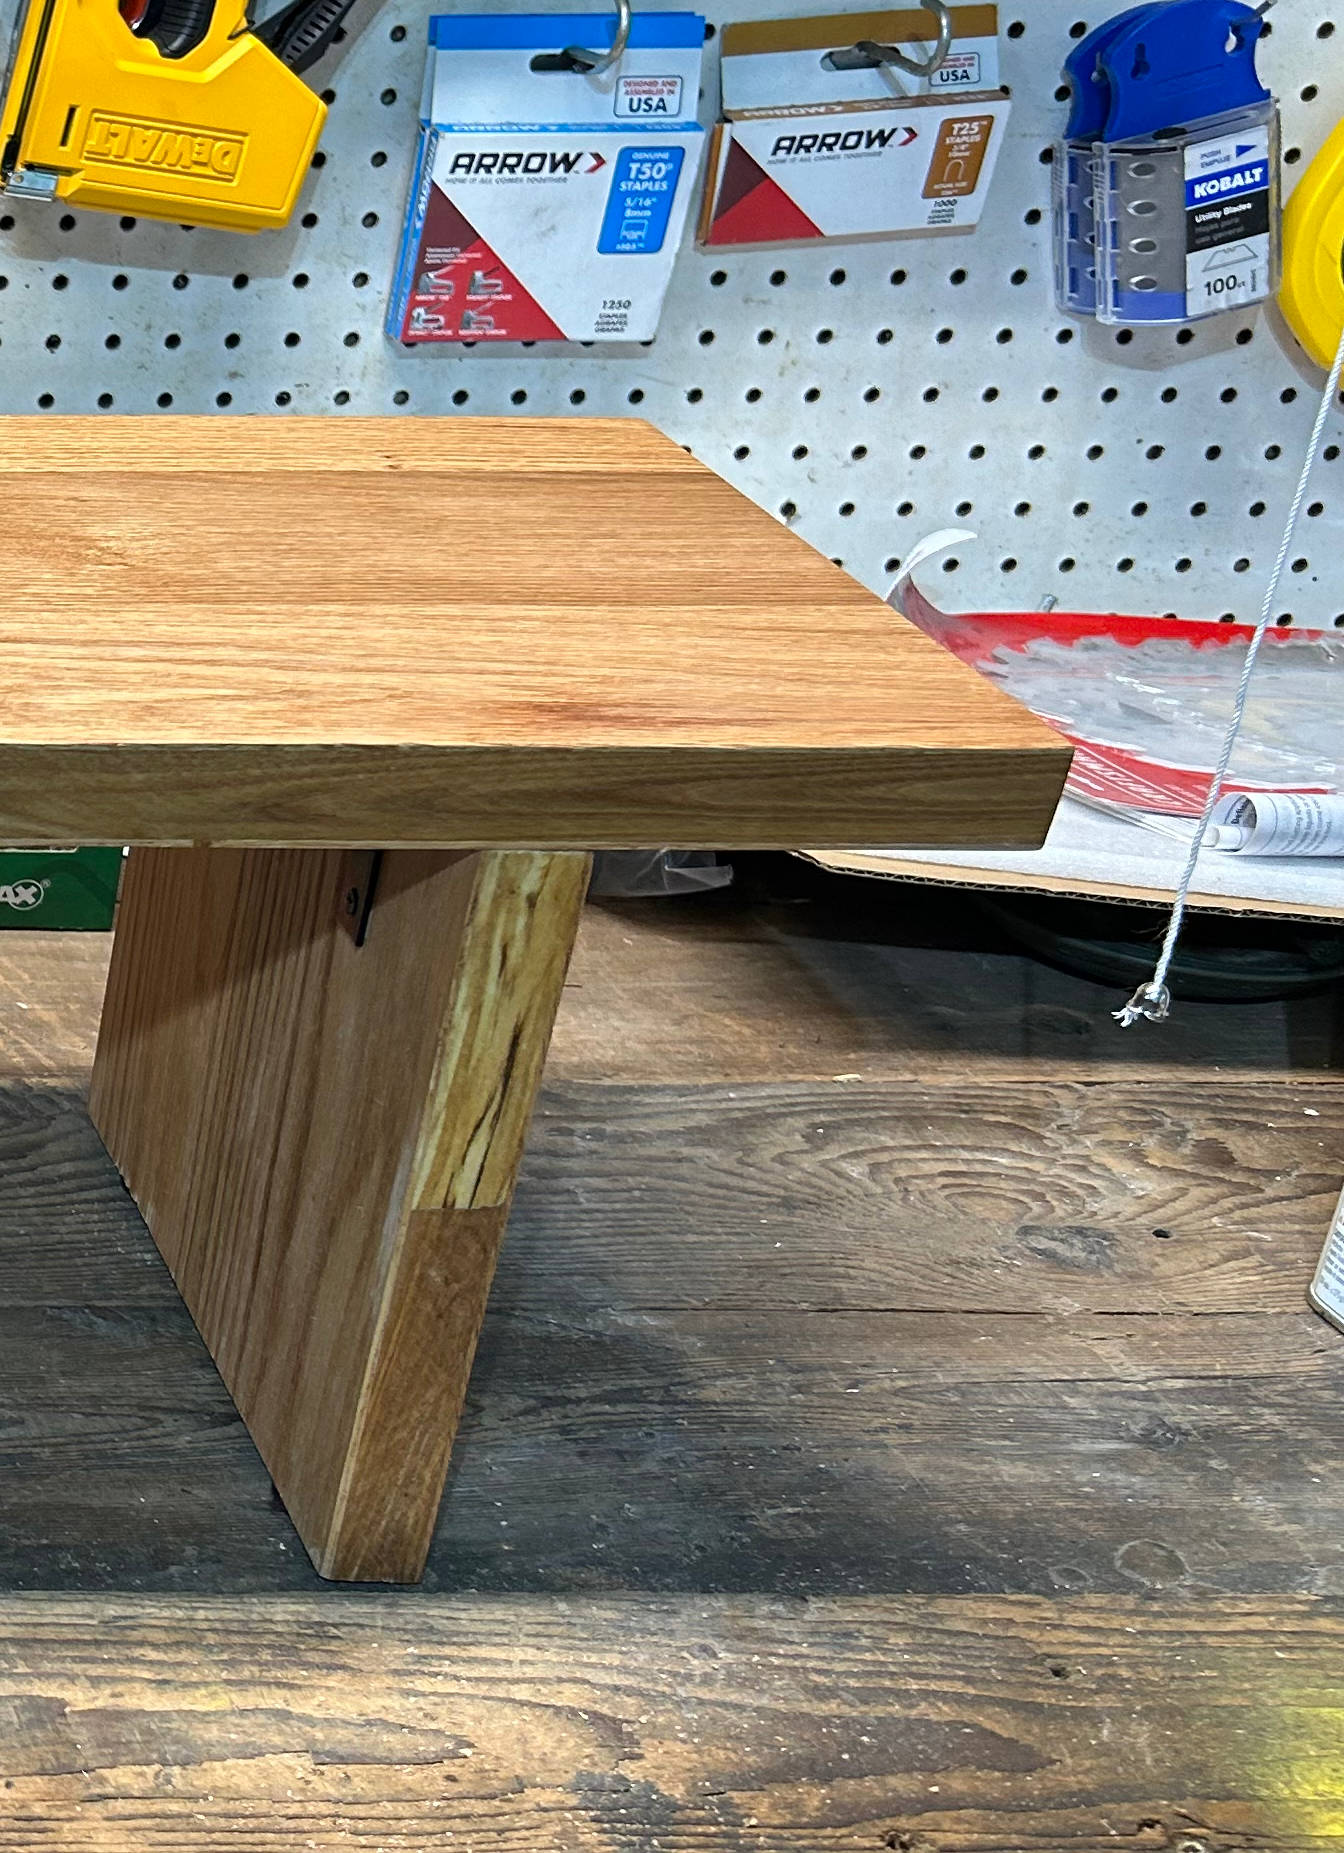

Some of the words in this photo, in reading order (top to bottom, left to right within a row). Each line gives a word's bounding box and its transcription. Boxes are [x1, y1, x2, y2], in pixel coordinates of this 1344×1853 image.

[939, 69, 970, 82] USA
[628, 97, 667, 113] USA
[952, 122, 979, 136] T25
[84, 121, 242, 174] DEWALT
[770, 127, 897, 156] ARROW
[448, 152, 584, 175] ARROW
[619, 181, 670, 192] STAPLES
[1194, 167, 1264, 199] KOBALT
[1195, 210, 1222, 223] Utility
[1223, 202, 1253, 216] Blades
[1204, 275, 1237, 296] 100
[602, 300, 632, 310] 1250
